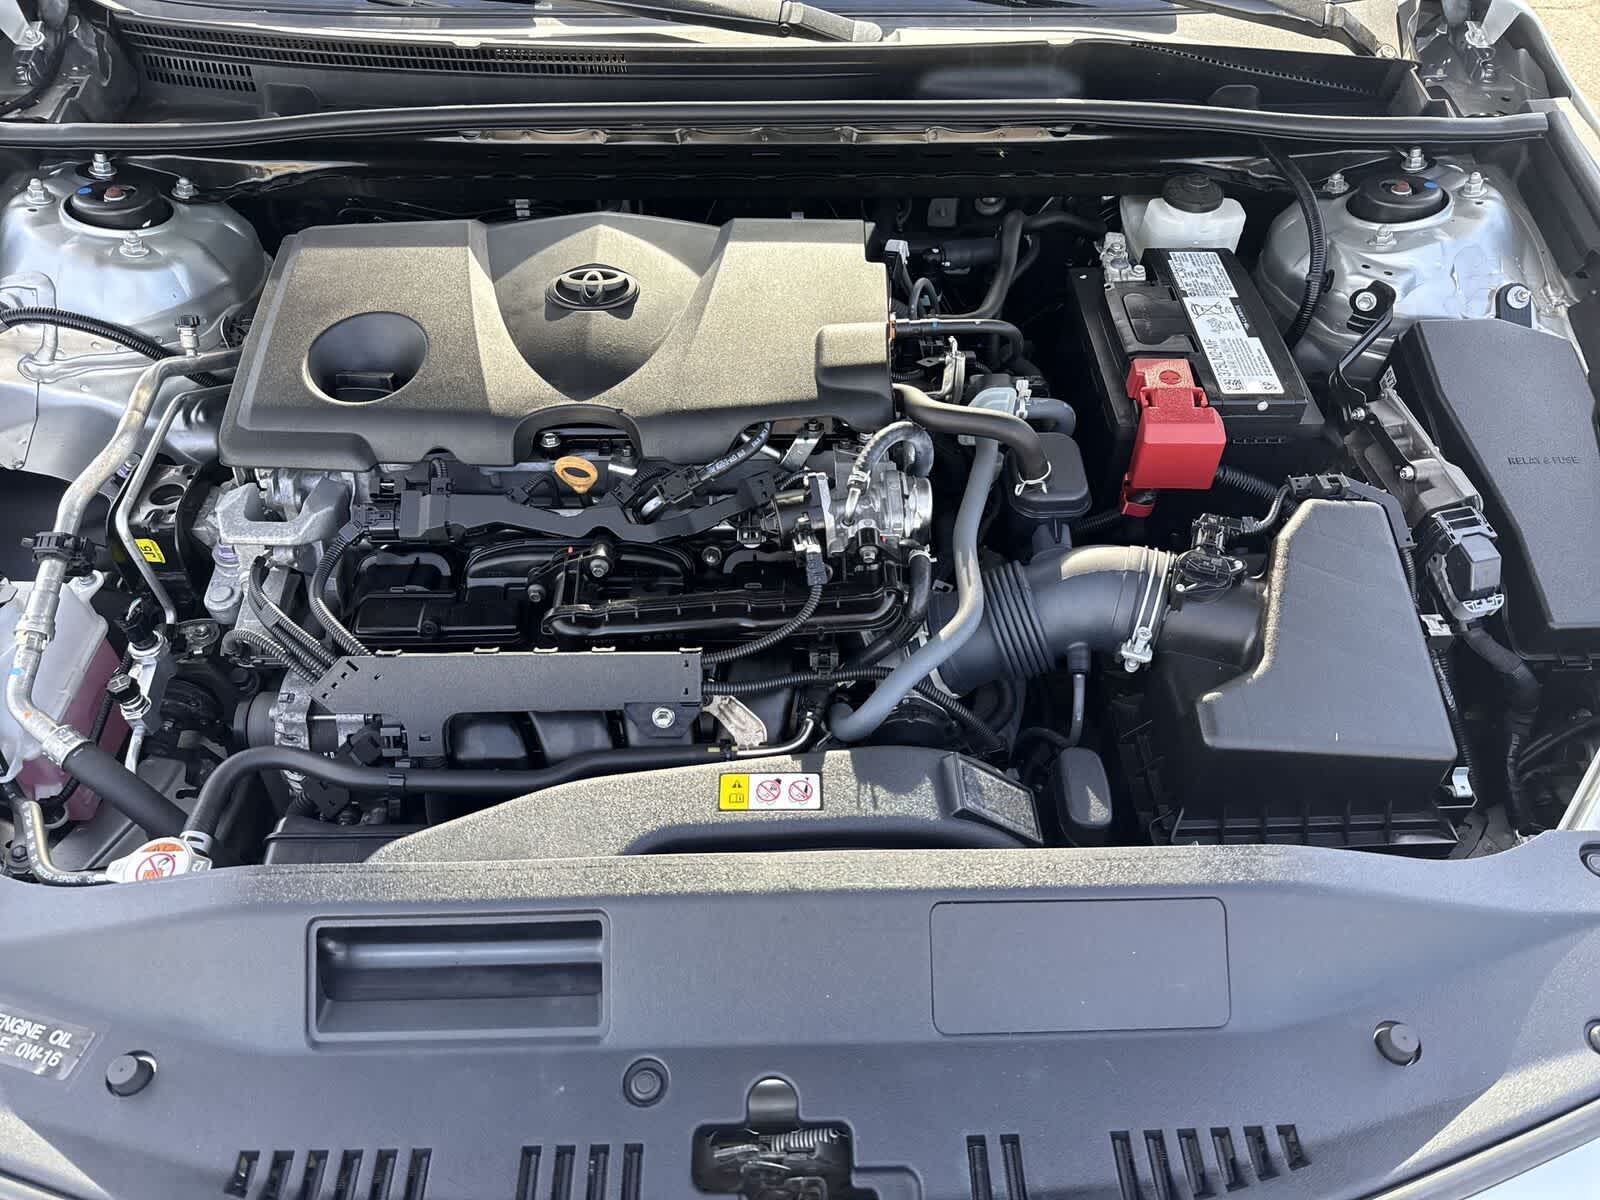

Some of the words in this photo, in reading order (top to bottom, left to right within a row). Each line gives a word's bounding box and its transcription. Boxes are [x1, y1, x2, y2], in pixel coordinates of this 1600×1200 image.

[1507, 456, 1541, 465] RELAY
[1551, 455, 1581, 464] FUSE
[48, 1029, 72, 1049] OIL
[14, 1042, 63, 1067] 0W-16
